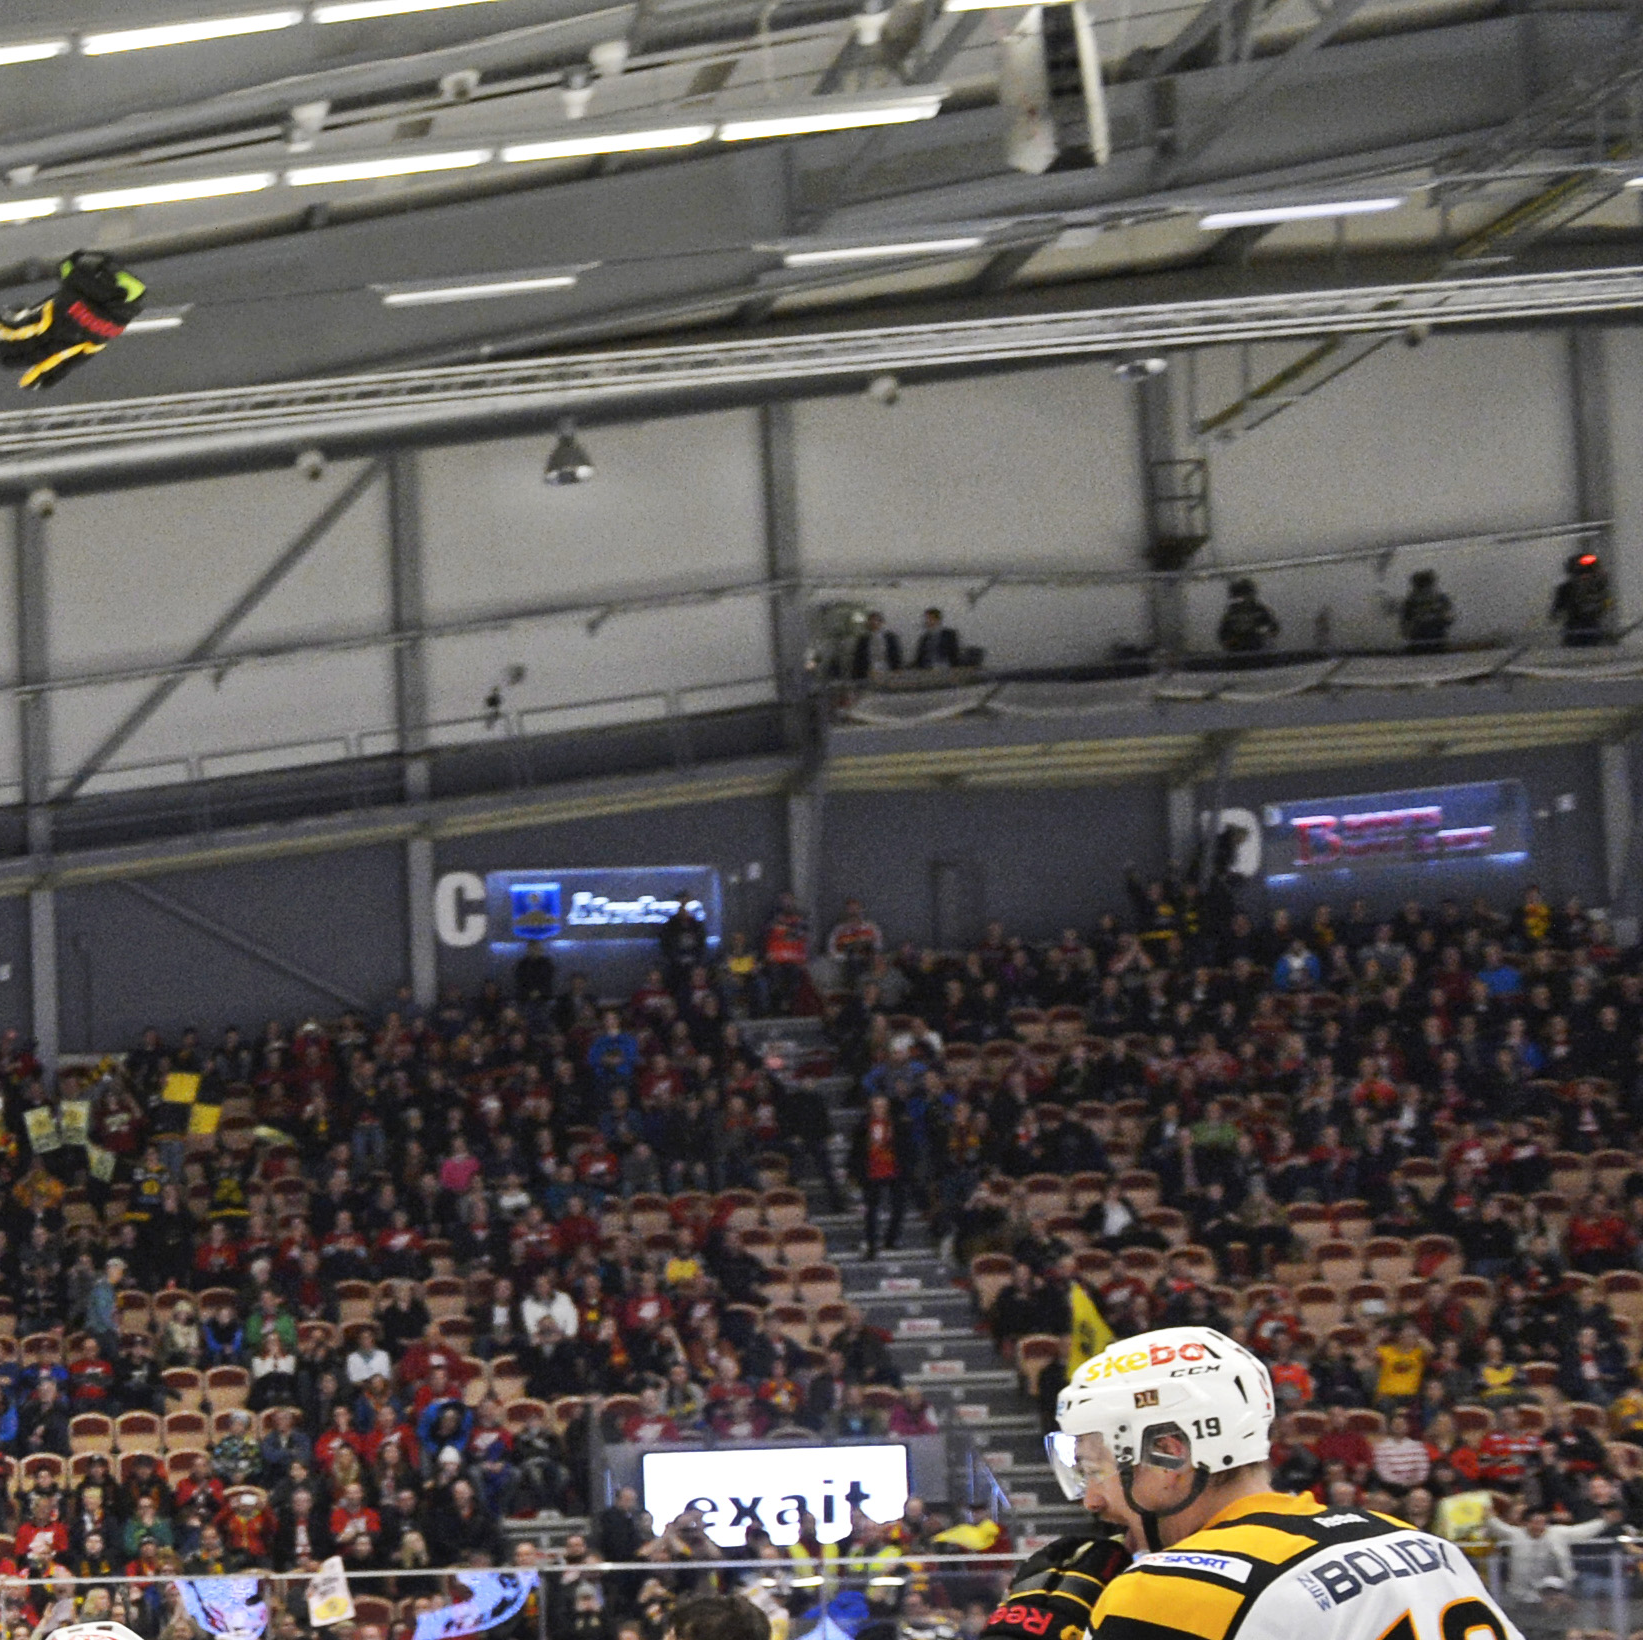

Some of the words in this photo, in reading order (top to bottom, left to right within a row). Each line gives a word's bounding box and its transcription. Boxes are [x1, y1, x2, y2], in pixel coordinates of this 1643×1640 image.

[434, 871, 487, 947] C
[1085, 1342, 1207, 1382] skebo
[1191, 1417, 1222, 1440] 19
